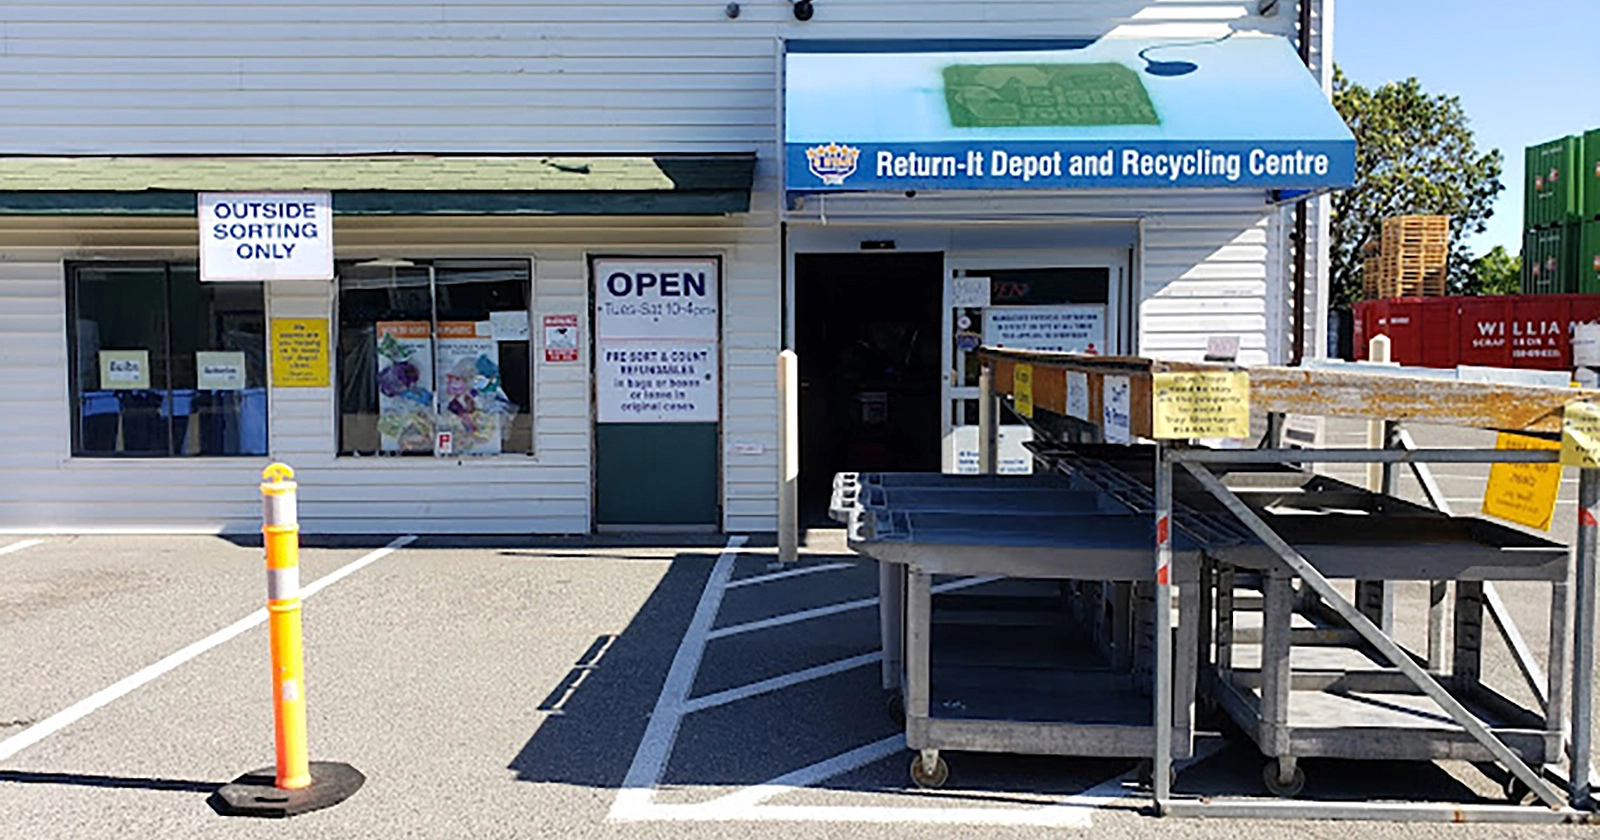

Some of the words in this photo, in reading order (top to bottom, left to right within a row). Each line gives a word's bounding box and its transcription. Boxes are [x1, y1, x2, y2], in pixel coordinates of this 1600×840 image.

[876, 150, 984, 177] Return-It
[991, 150, 1062, 183] Depot
[1069, 149, 1114, 176] and
[1122, 148, 1241, 181] Recycling
[1249, 148, 1329, 176] Centre
[213, 202, 316, 219] OUTSIDE
[213, 222, 318, 240] SORTING
[236, 243, 296, 259] ONLY
[606, 272, 706, 297] OPEN
